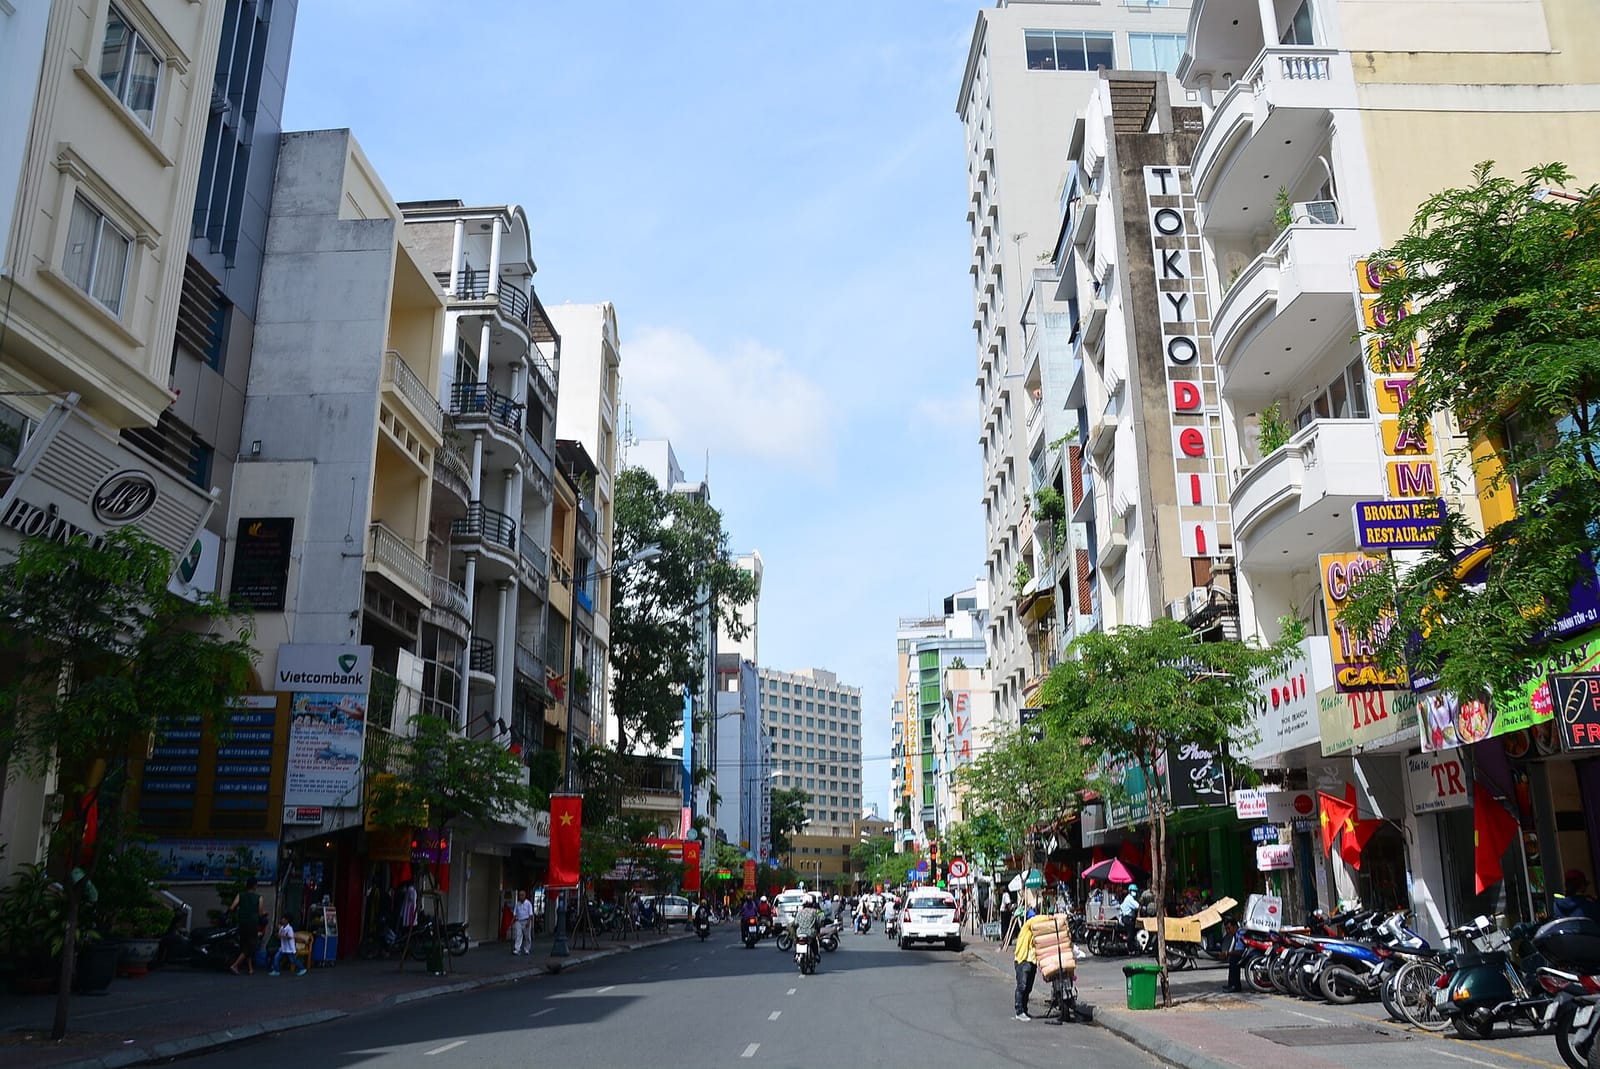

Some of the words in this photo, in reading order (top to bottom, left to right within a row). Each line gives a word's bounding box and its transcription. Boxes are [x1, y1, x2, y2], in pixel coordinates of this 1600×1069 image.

[1151, 168, 1197, 366] TOKYO
[1364, 504, 1410, 521] BROKEN
[279, 670, 363, 686] Vietcombank
[956, 693, 969, 760] EVA
[1431, 760, 1466, 797] TR
